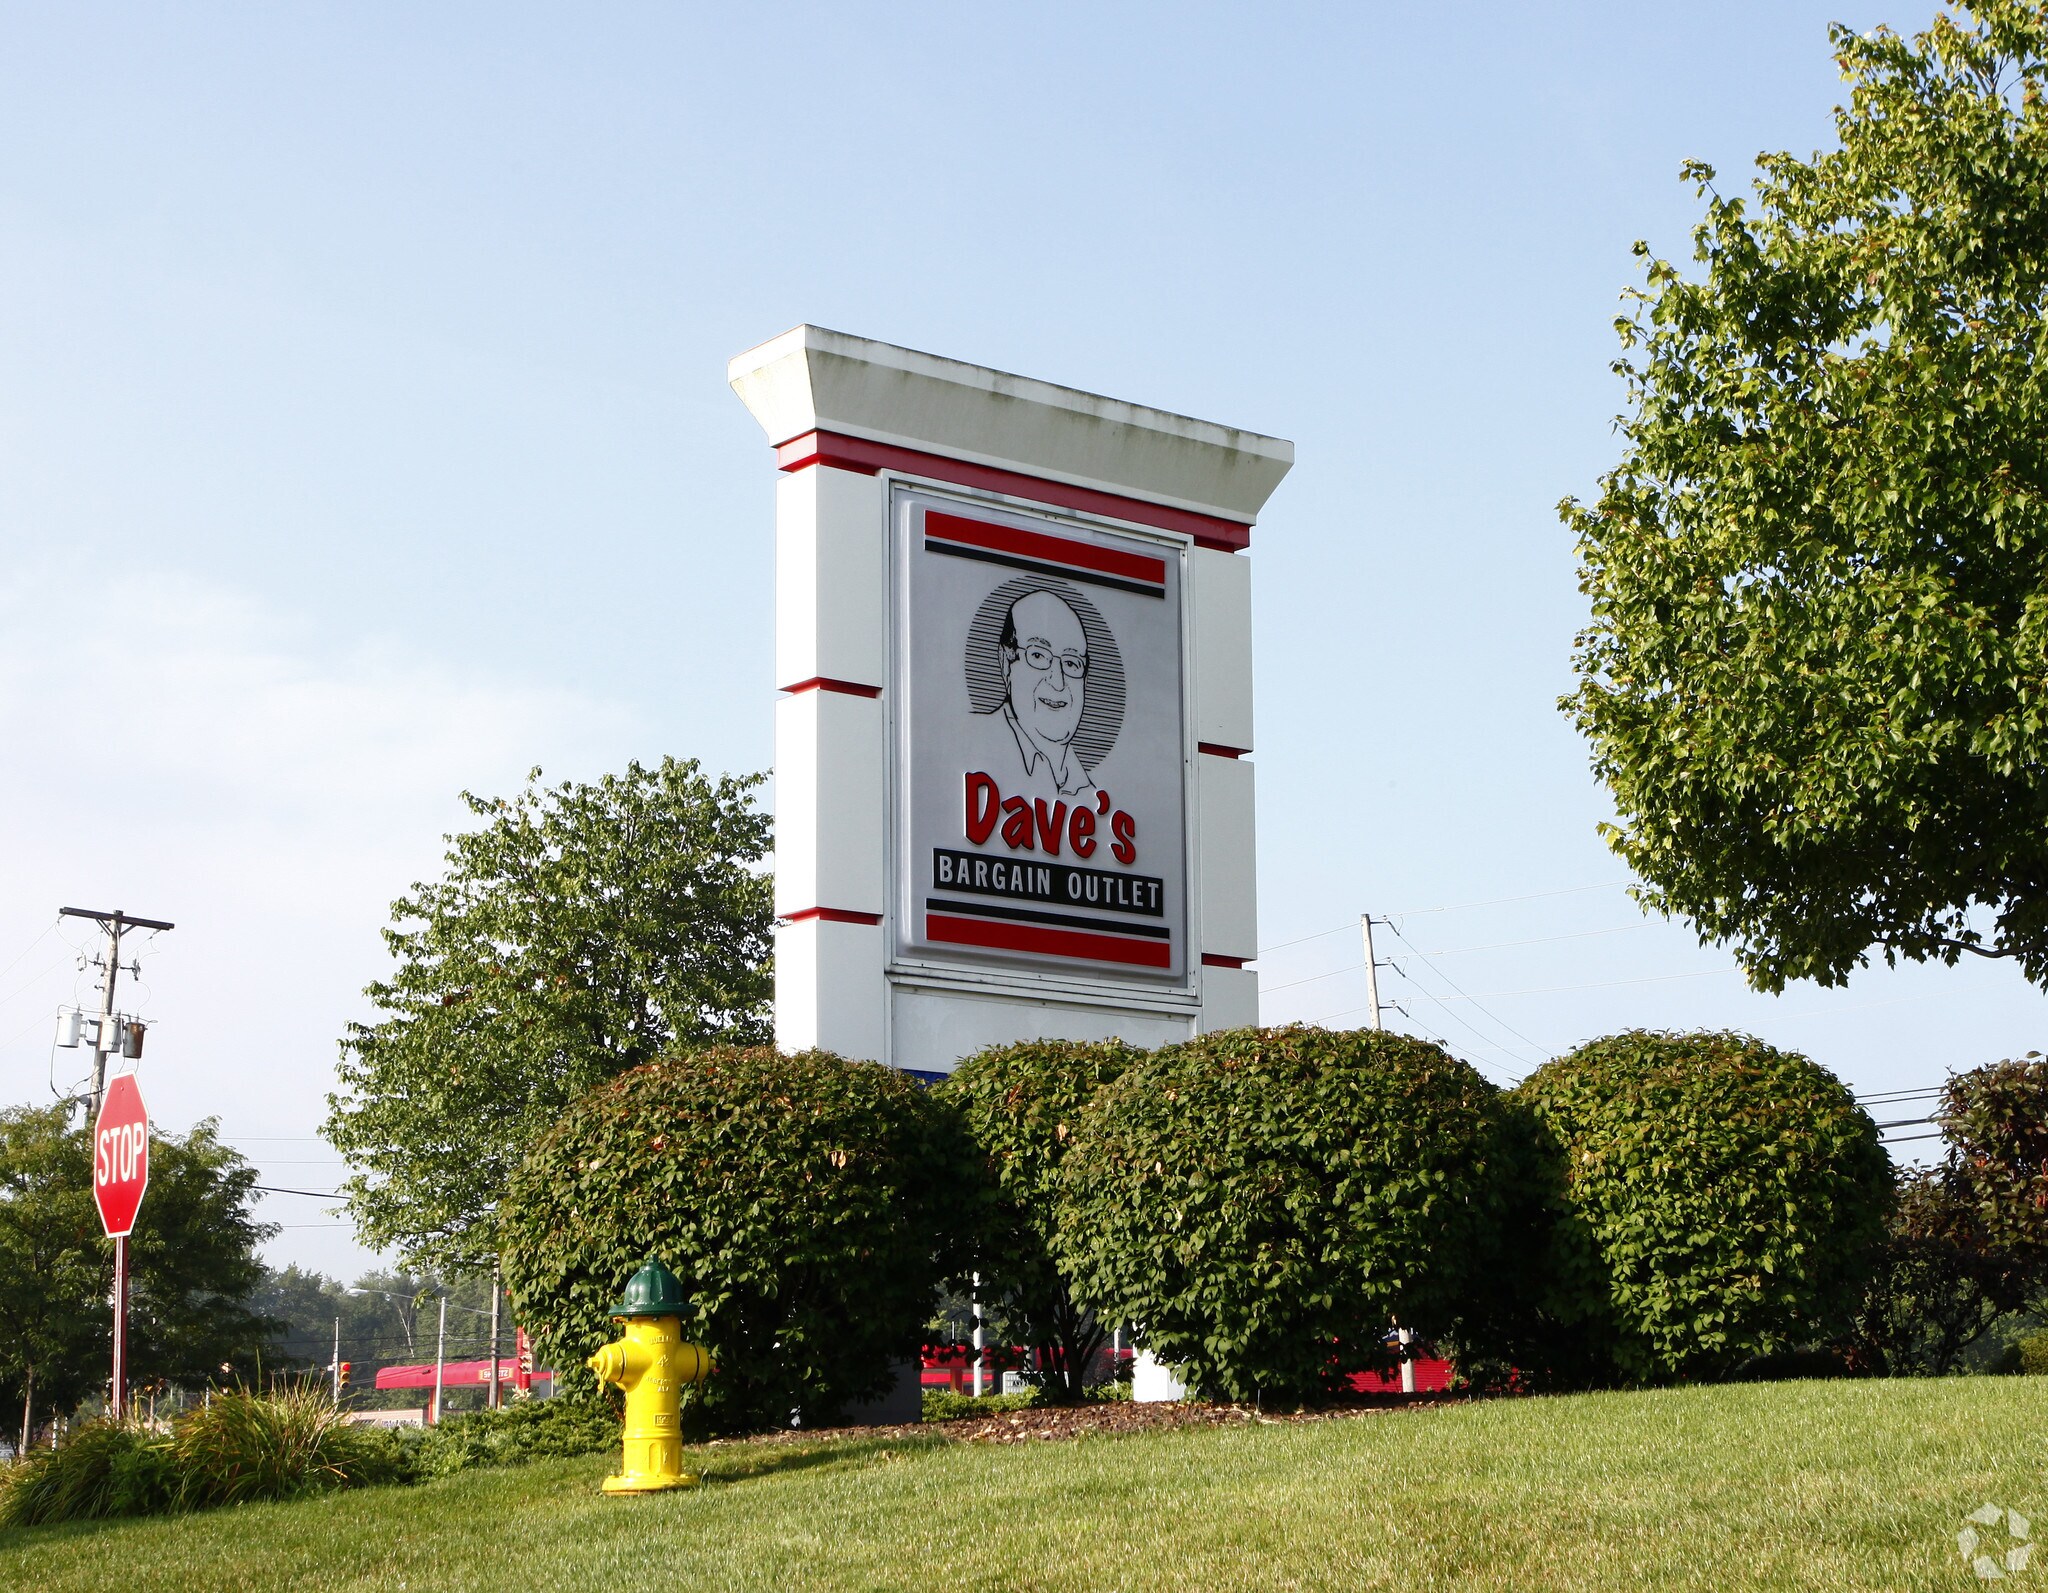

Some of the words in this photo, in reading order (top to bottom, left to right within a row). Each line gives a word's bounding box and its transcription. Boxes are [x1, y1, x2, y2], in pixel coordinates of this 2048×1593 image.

[963, 771, 1136, 865] Dave's
[939, 855, 1050, 895] BARGAIN
[1068, 872, 1159, 909] OUTLET
[98, 1122, 145, 1187] STOP
